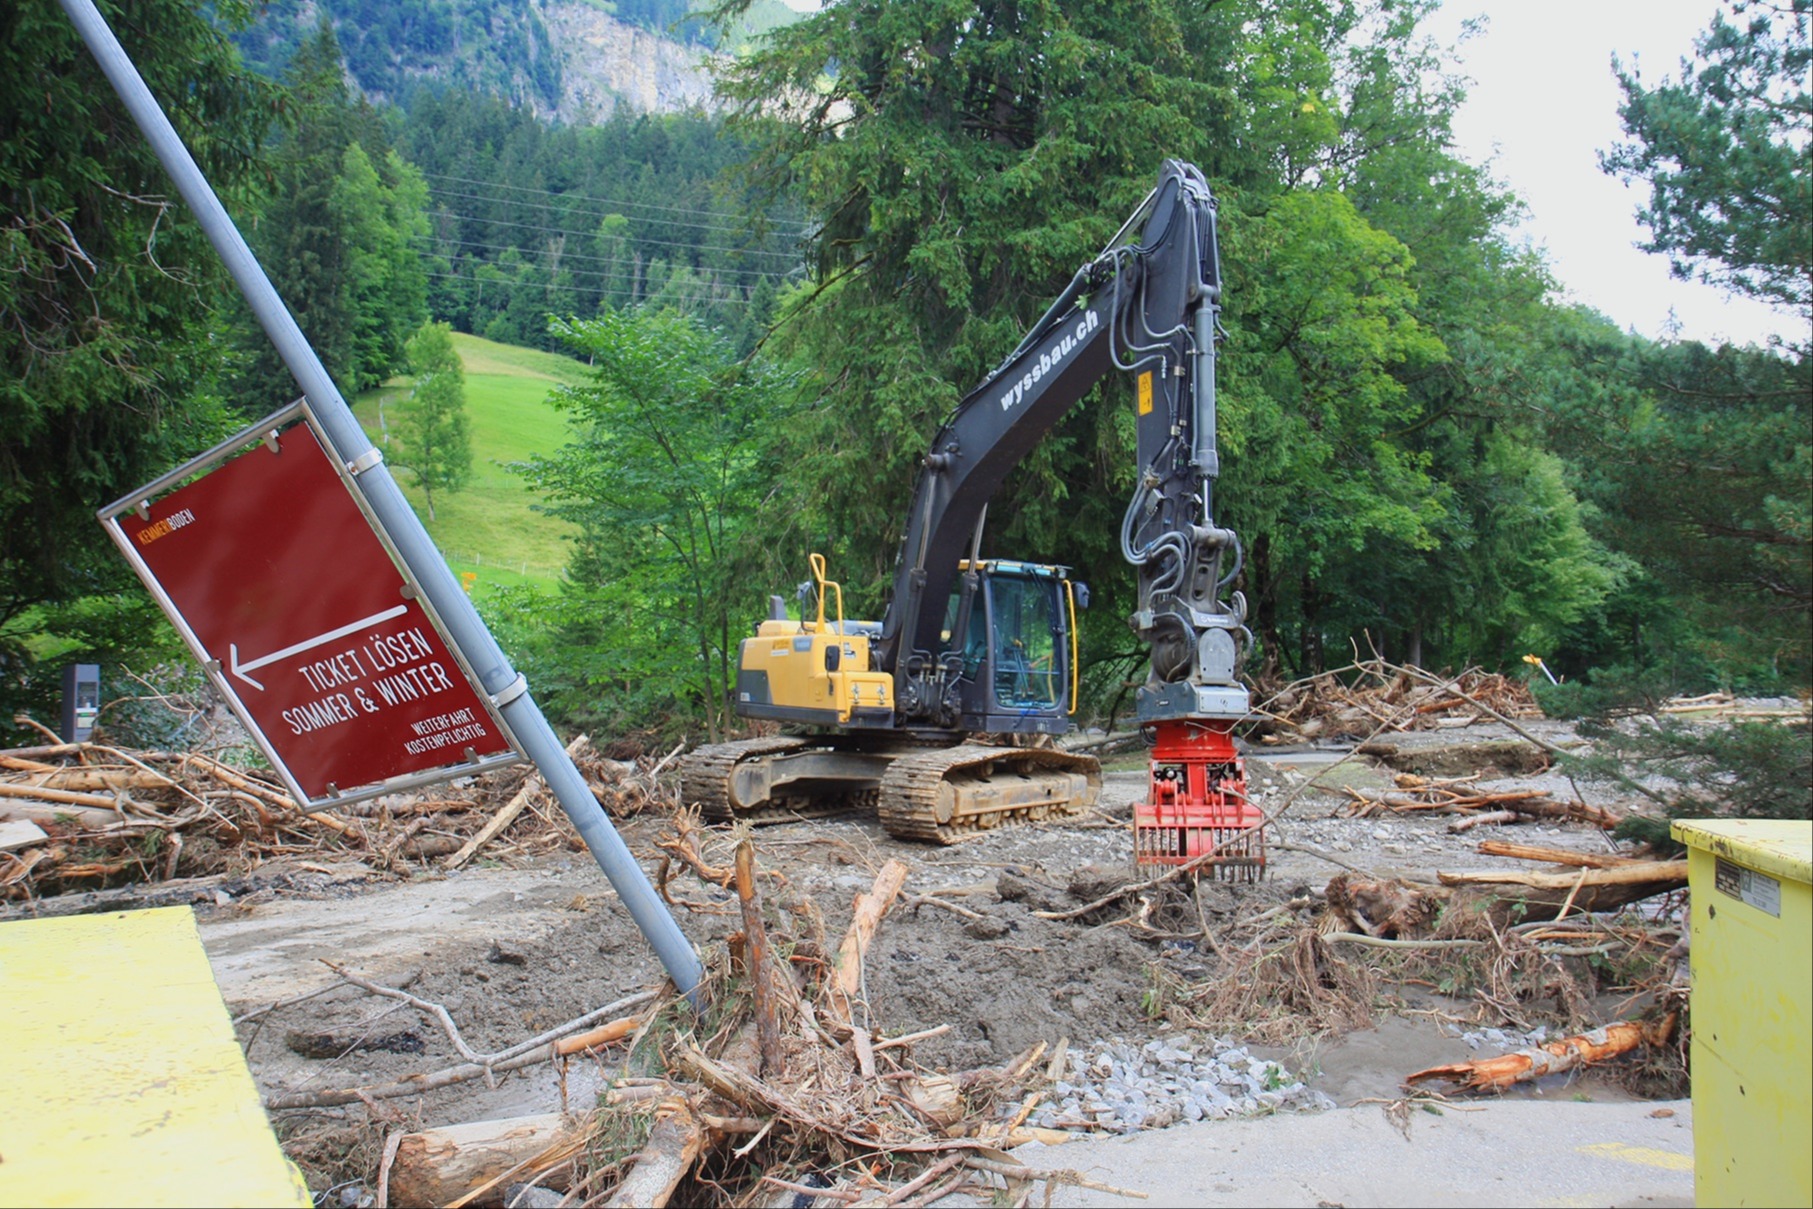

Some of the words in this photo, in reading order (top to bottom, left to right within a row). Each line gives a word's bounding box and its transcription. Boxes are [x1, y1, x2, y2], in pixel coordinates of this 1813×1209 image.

[1000, 308, 1099, 411] wyssbau.ch
[298, 650, 367, 693] TICKET
[363, 627, 434, 672] LÖSEN
[282, 693, 359, 735] SOMMER
[354, 687, 380, 714] &
[372, 661, 454, 706] WINTER
[410, 707, 476, 736] WEITERFAHRT
[403, 722, 487, 755] KOSTENPFLICHTIG
